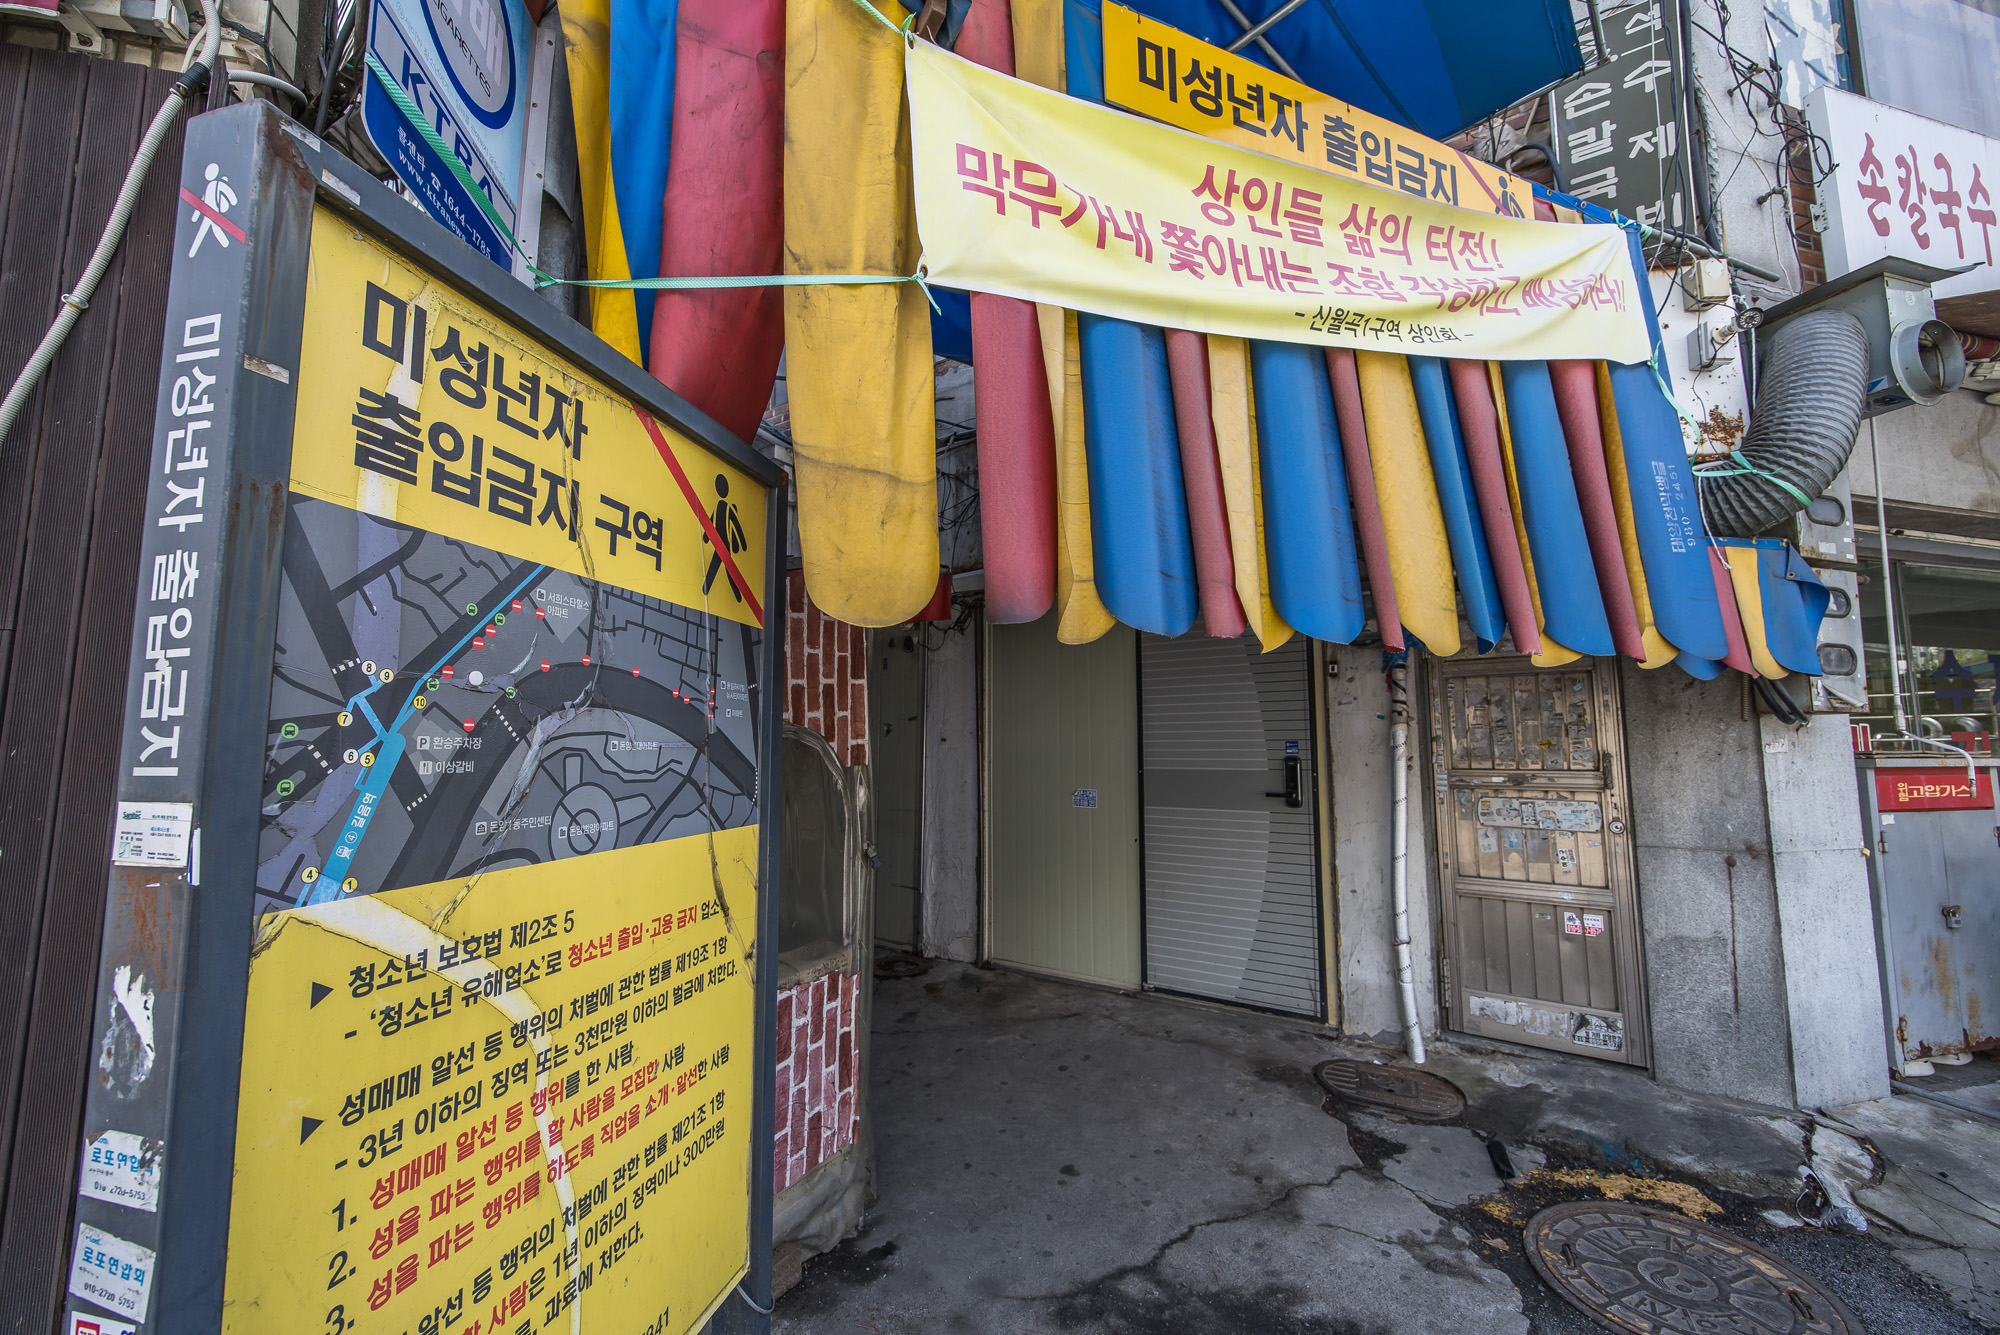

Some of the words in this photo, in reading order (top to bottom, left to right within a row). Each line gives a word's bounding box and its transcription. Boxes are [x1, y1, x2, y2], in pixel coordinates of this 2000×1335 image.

[1138, 37, 1310, 153] 미성년자
[1322, 114, 1460, 206] 출입금지
[955, 142, 1154, 264] 막무가내
[1326, 261, 1408, 302] 조합
[1399, 274, 1521, 317] 각성하고
[1522, 272, 1626, 313] 배상하라!!
[1191, 164, 1325, 248] 상인들
[1339, 203, 1413, 266] 삶의
[1425, 224, 1504, 271] 터전!
[1857, 132, 1997, 267] 손칼국수
[1309, 305, 1403, 342] 신월곡1구역
[1407, 323, 1462, 344] 상인회
[361, 279, 590, 462] 미성년자
[157, 312, 222, 534] 미성년자
[351, 386, 581, 543] 출입금지
[594, 494, 665, 573] 구역
[546, 604, 569, 619] 아파트
[132, 550, 200, 778] 출입금지
[365, 662, 374, 674] 8
[383, 670, 391, 682] 9
[415, 697, 426, 709] 10
[341, 713, 349, 726] 7
[347, 750, 355, 762] 6
[363, 754, 371, 765] 5
[433, 736, 482, 750] 환승주차장
[351, 792, 377, 829] 길음역
[435, 760, 475, 774] 이상갈비
[307, 868, 314, 881] 4
[347, 878, 353, 890] 1
[348, 949, 429, 999] 청소년
[437, 928, 503, 971] 보호법
[509, 913, 558, 949] 제2조
[563, 909, 575, 934] 5
[567, 932, 613, 968] 청소년
[676, 904, 698, 930] 금지
[701, 898, 720, 921] 업소
[337, 1063, 422, 1127] 성매매
[431, 1041, 475, 1087] 알선
[483, 1030, 503, 1062] 등
[510, 1004, 563, 1049] 행위의
[569, 982, 614, 1022] 처벌에
[617, 970, 645, 1001] 관한
[649, 959, 672, 987] 법률
[675, 943, 709, 975] 제19조
[712, 936, 728, 957] 1항
[358, 1118, 404, 1168] 3년
[414, 1080, 483, 1135] 이하의
[490, 1058, 529, 1099] 징역
[535, 1043, 569, 1077] 또는
[574, 1010, 628, 1056] 3천만원
[633, 990, 668, 1024] 이하의
[672, 973, 704, 1007] 벌금에
[707, 959, 738, 987] 처한다.
[327, 1250, 356, 1291] 2.
[368, 1205, 421, 1260] 성을
[429, 1176, 476, 1222] 파는
[484, 1131, 541, 1186] 행위를
[547, 1115, 565, 1148] 할
[570, 1085, 616, 1131] 사람을
[620, 1058, 658, 1100] 모집한
[661, 1043, 685, 1073] 사람
[331, 1198, 358, 1233] 1.
[369, 1142, 448, 1210] 성매매
[456, 1115, 497, 1163] 알선
[505, 1101, 524, 1133] 등
[530, 1070, 581, 1117] 행위를
[586, 1061, 601, 1086] 한
[605, 1040, 634, 1073] 사람
[325, 1304, 355, 1335] 3.
[366, 1253, 419, 1312] 성을
[427, 1220, 475, 1269] 파는
[482, 1170, 541, 1229] 행위를
[547, 1133, 596, 1184] 하도록
[600, 1103, 641, 1145] 직업을
[710, 1044, 730, 1070] 사람
[417, 1287, 463, 1335] 알선
[471, 1266, 493, 1304] 등
[499, 1217, 556, 1280] 행위의
[562, 1177, 608, 1233] 처벌에
[612, 1153, 640, 1193] 관한
[644, 1132, 668, 1169] 법률
[671, 1104, 707, 1147] 제21조
[709, 1089, 725, 1113] 1항
[487, 1265, 547, 1335] 사람은
[552, 1237, 578, 1279] 1년
[584, 1196, 628, 1250] 이하의
[632, 1155, 681, 1211] 징역이나
[683, 1117, 726, 1168] 300만원
[598, 1219, 645, 1276] 처한다.
